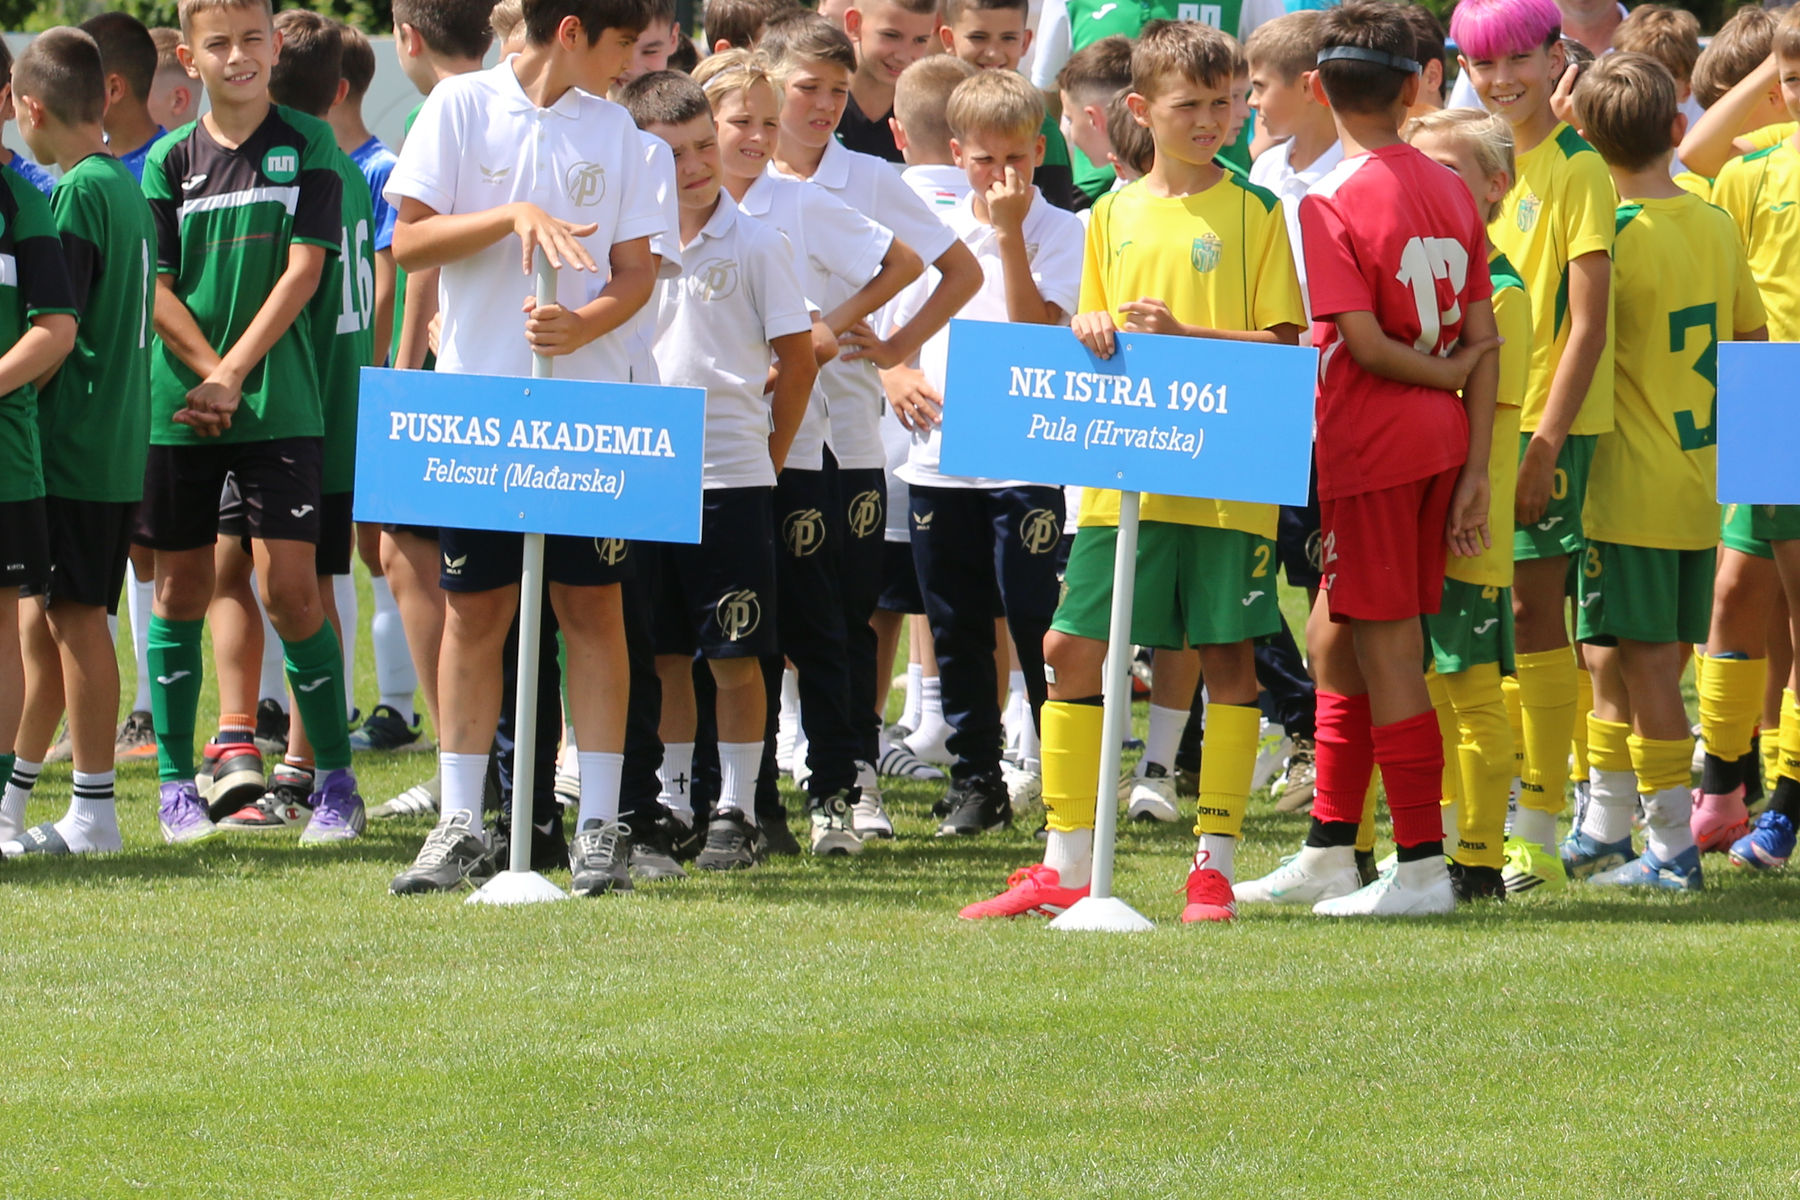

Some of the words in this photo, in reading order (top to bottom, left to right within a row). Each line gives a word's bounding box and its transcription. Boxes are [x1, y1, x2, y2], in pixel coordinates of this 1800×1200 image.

[335, 218, 374, 335] 16
[1008, 365, 1057, 399] NK
[1063, 370, 1157, 409] ISTRA
[1167, 380, 1228, 415] 1961
[1668, 302, 1717, 452] 3
[389, 411, 501, 447] PUSKAS
[507, 418, 676, 458] AKADEMIA
[1026, 413, 1078, 443] Pula
[1084, 418, 1204, 460] (Hrvatska)
[423, 456, 499, 486] Felcsut
[503, 462, 626, 500] (Mađarska)
[1251, 544, 1271, 579] 2
[1584, 547, 1603, 578] 3
